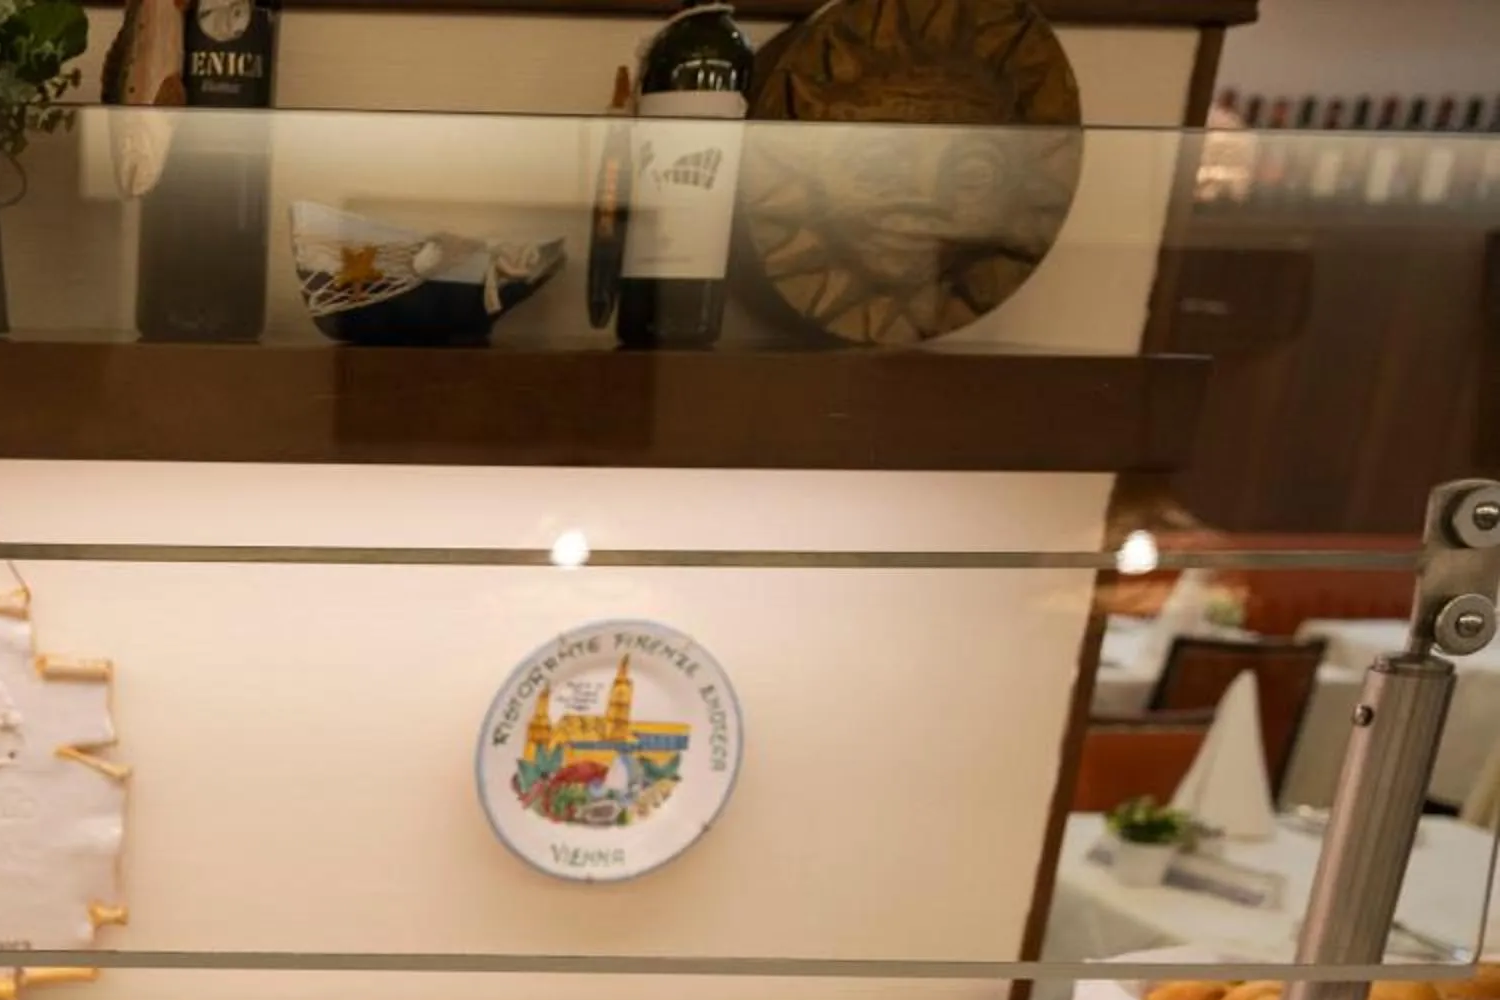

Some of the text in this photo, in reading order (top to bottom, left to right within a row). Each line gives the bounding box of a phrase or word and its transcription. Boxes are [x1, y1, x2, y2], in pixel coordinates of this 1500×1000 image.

[492, 636, 600, 747] RISTORANTE
[614, 632, 699, 678] FIRENZE
[550, 843, 626, 867] VIENNA
